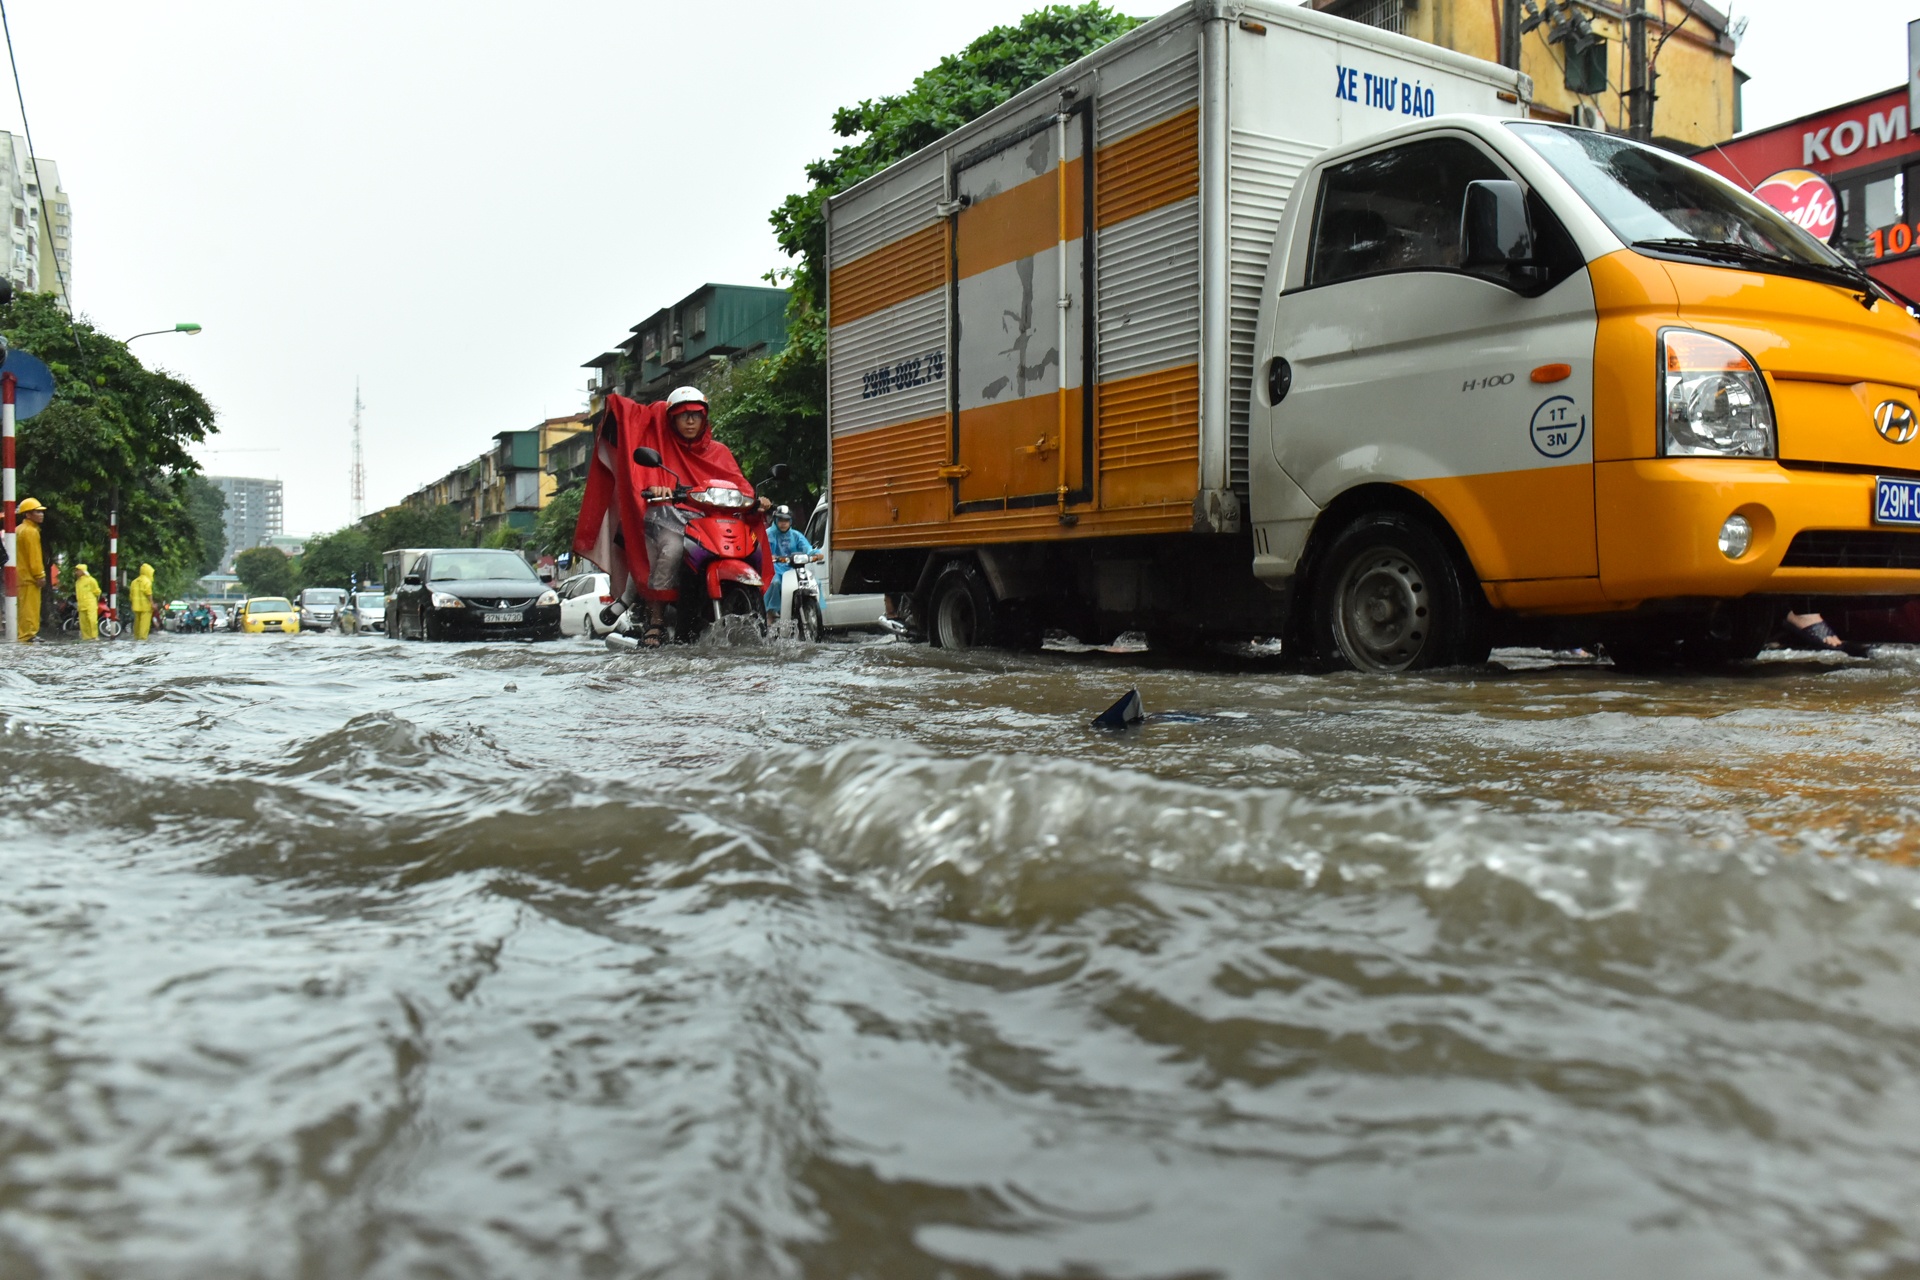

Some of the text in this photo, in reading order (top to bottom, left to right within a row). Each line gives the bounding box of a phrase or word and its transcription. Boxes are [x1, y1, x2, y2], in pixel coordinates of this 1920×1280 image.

[1335, 65, 1434, 118] XE THƯ BÁO
[1781, 188, 1837, 230] mbo
[1868, 222, 1920, 259] 10
[1461, 373, 1515, 393] H-100
[1549, 407, 1568, 422] 1T
[1547, 432, 1568, 447] 3N
